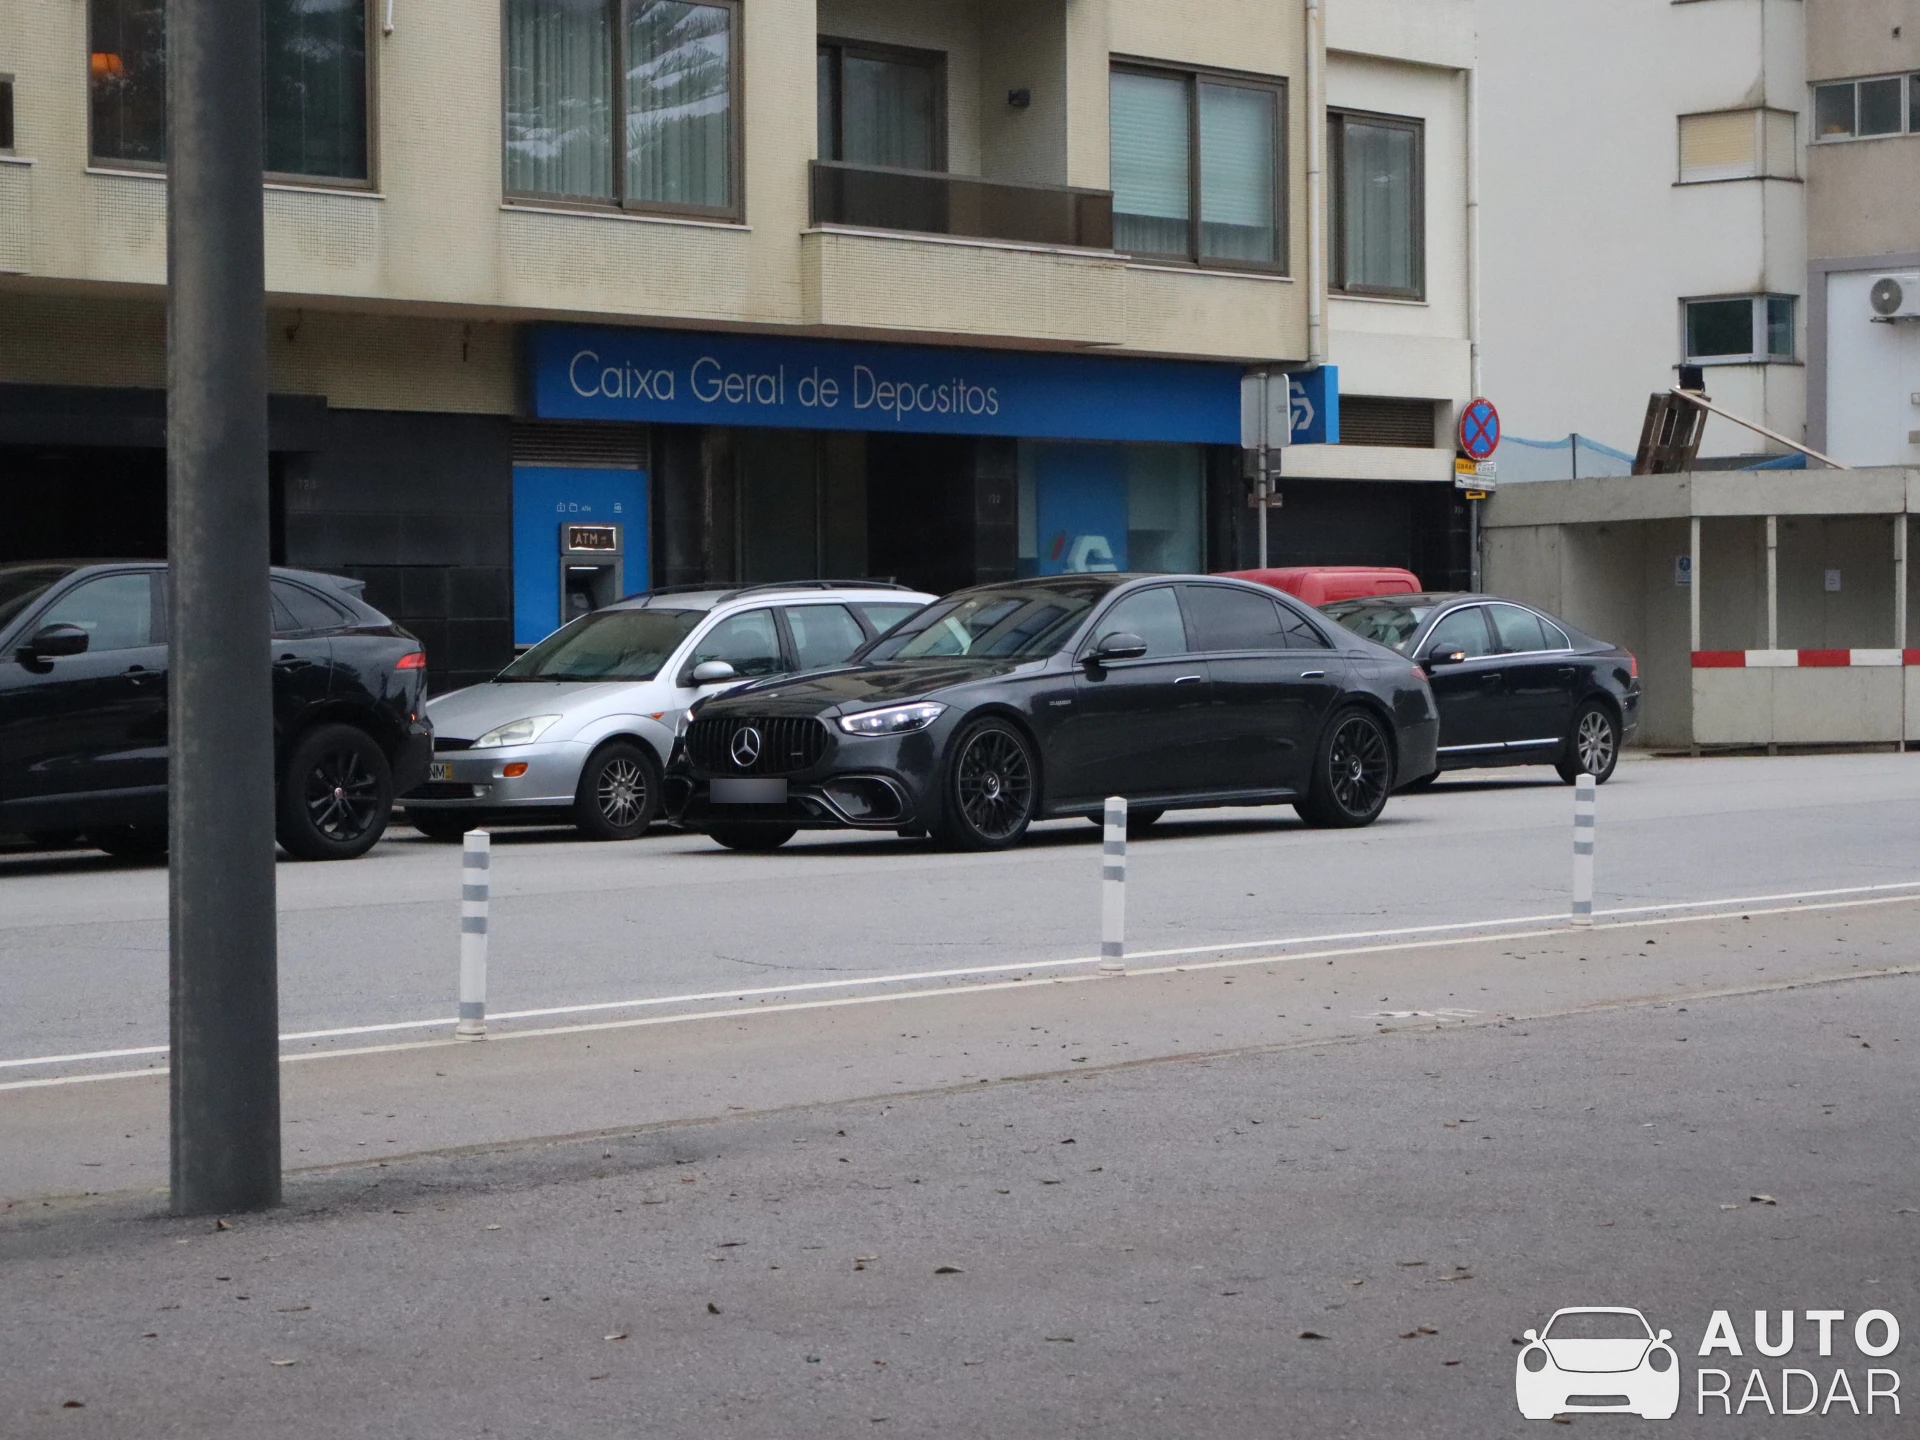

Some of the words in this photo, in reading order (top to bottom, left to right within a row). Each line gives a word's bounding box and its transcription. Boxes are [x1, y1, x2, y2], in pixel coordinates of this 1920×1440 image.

[569, 350, 675, 401] Caixa
[690, 356, 785, 405] Geral
[798, 366, 839, 408] de
[575, 532, 598, 545] ATM
